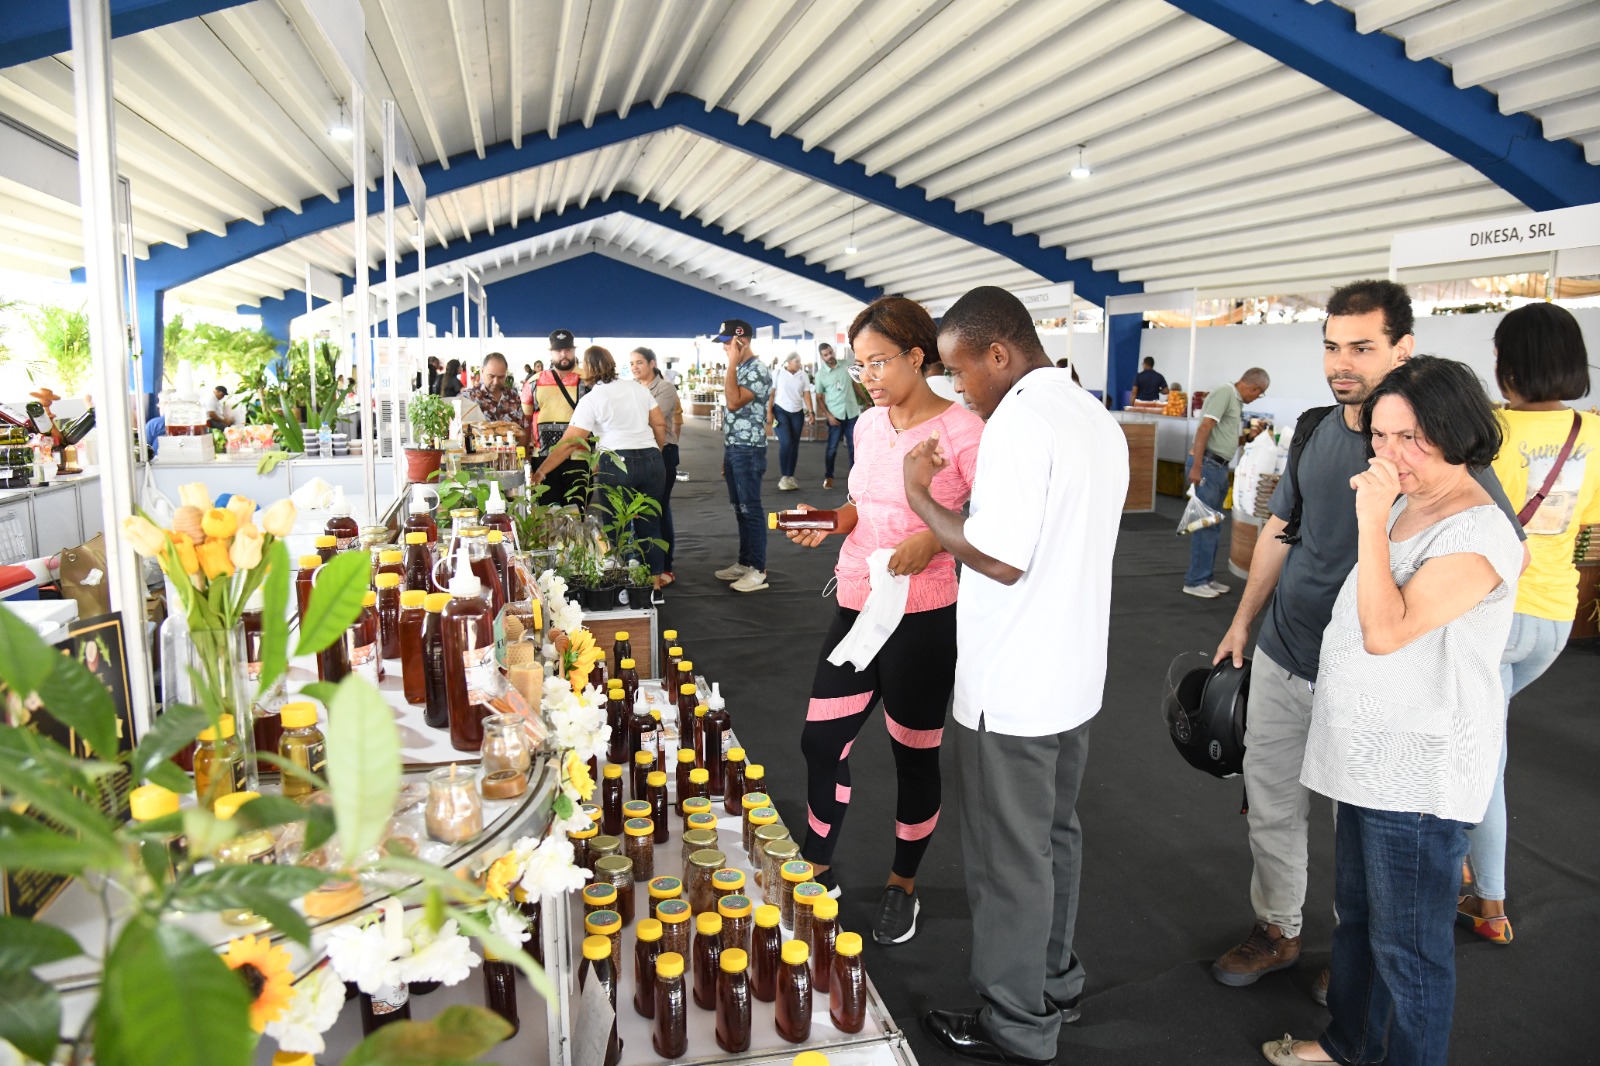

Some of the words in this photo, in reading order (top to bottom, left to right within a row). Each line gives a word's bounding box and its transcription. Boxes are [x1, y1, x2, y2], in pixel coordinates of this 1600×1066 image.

[1470, 227, 1524, 246] DIKESA,
[1528, 222, 1555, 239] SRL
[1519, 441, 1595, 468] Sumer
